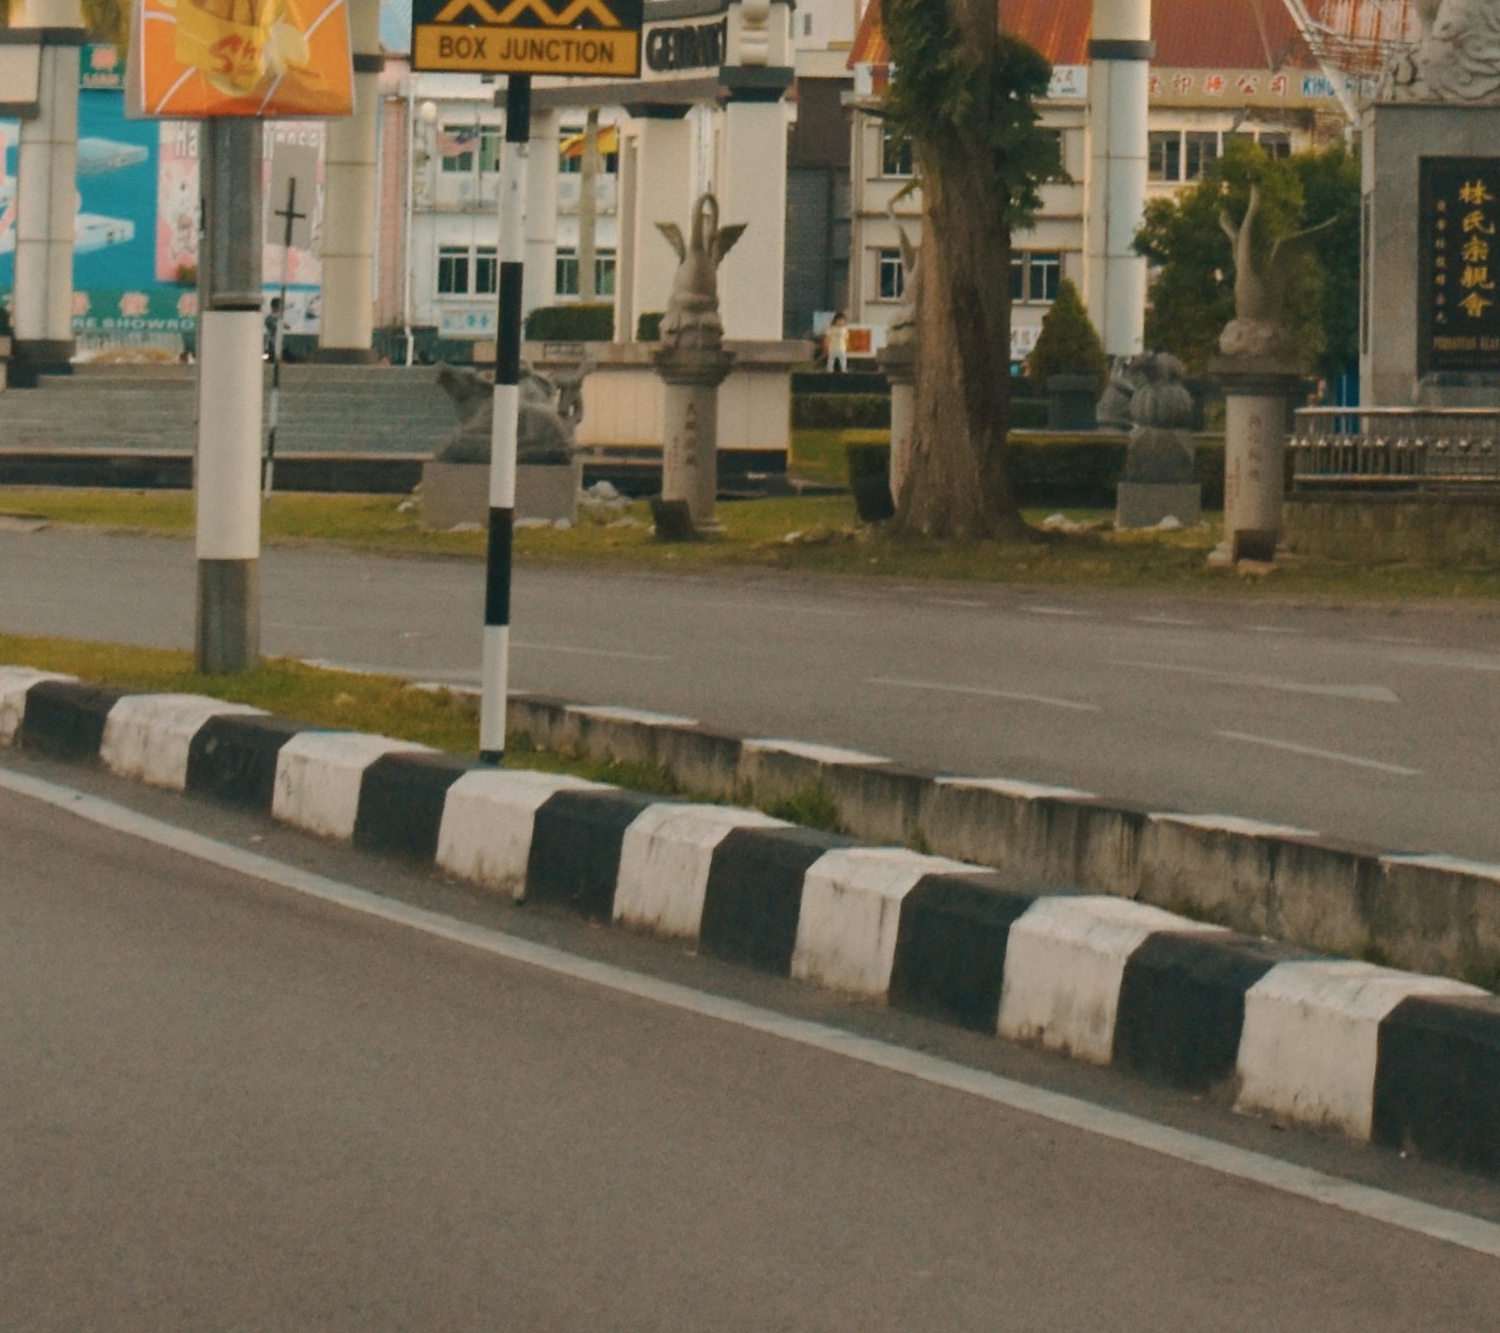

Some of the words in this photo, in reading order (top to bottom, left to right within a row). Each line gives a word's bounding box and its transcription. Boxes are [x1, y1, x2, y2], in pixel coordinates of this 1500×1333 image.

[438, 35, 487, 60] BOX
[500, 37, 614, 64] JUNCTION
[105, 316, 197, 331] SHOWRO
